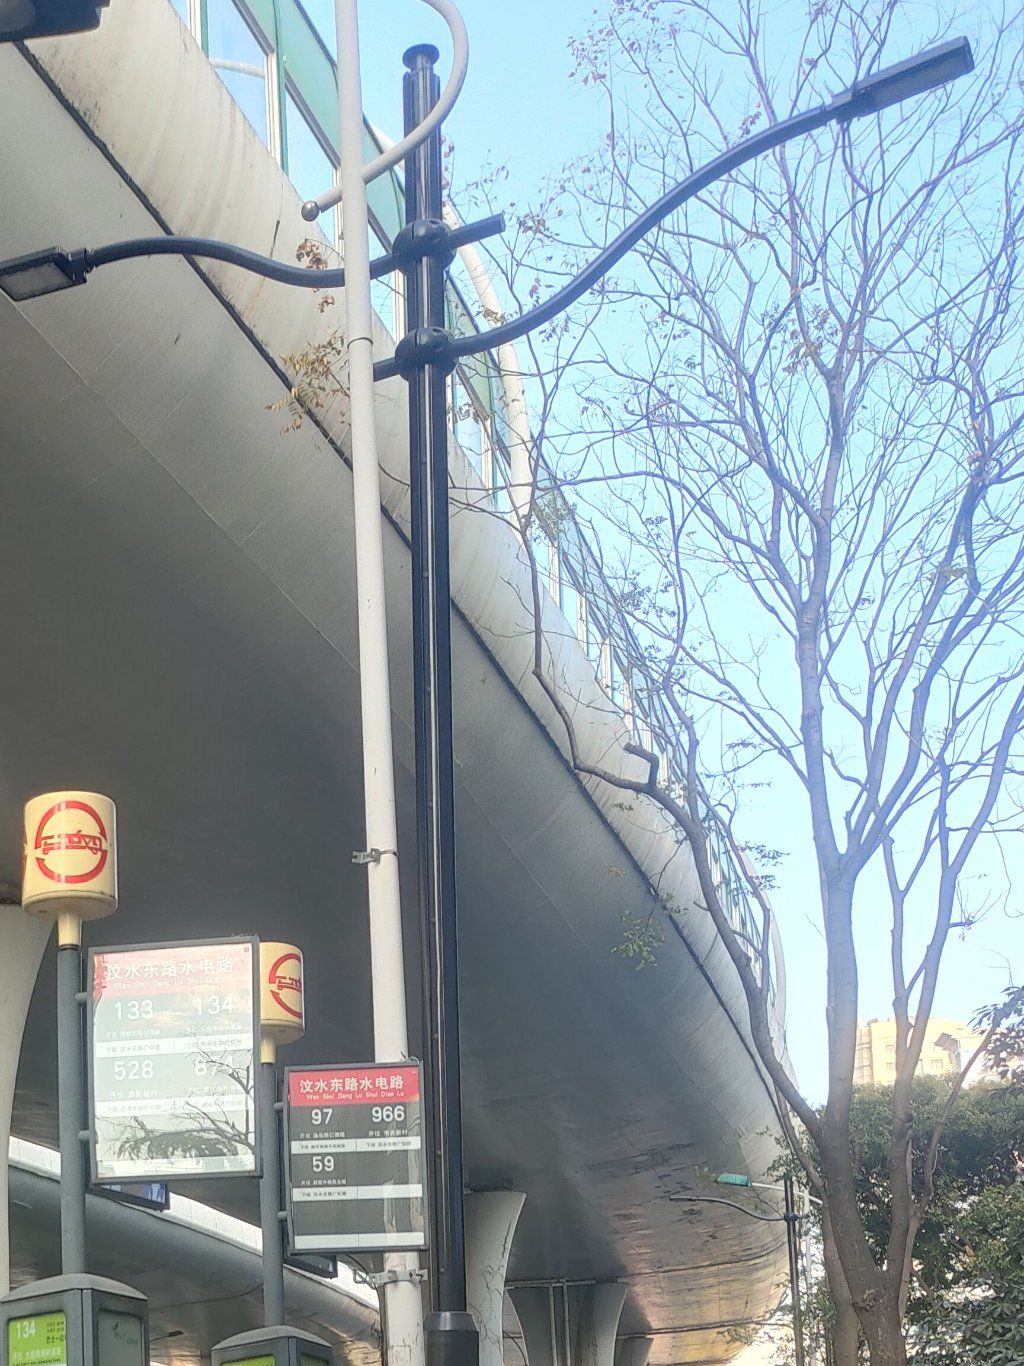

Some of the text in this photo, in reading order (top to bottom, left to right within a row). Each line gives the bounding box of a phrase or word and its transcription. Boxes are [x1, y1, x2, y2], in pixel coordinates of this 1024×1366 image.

[106, 956, 234, 980] 汶水东路水电路
[114, 994, 235, 1021] 133 134
[114, 1059, 155, 1081] 528
[299, 1074, 405, 1094] 汶水东路水电路
[306, 1093, 320, 1101] Wen
[311, 1104, 406, 1126] 97 966
[312, 1155, 335, 1173] 59
[16, 1319, 36, 1339] 134
